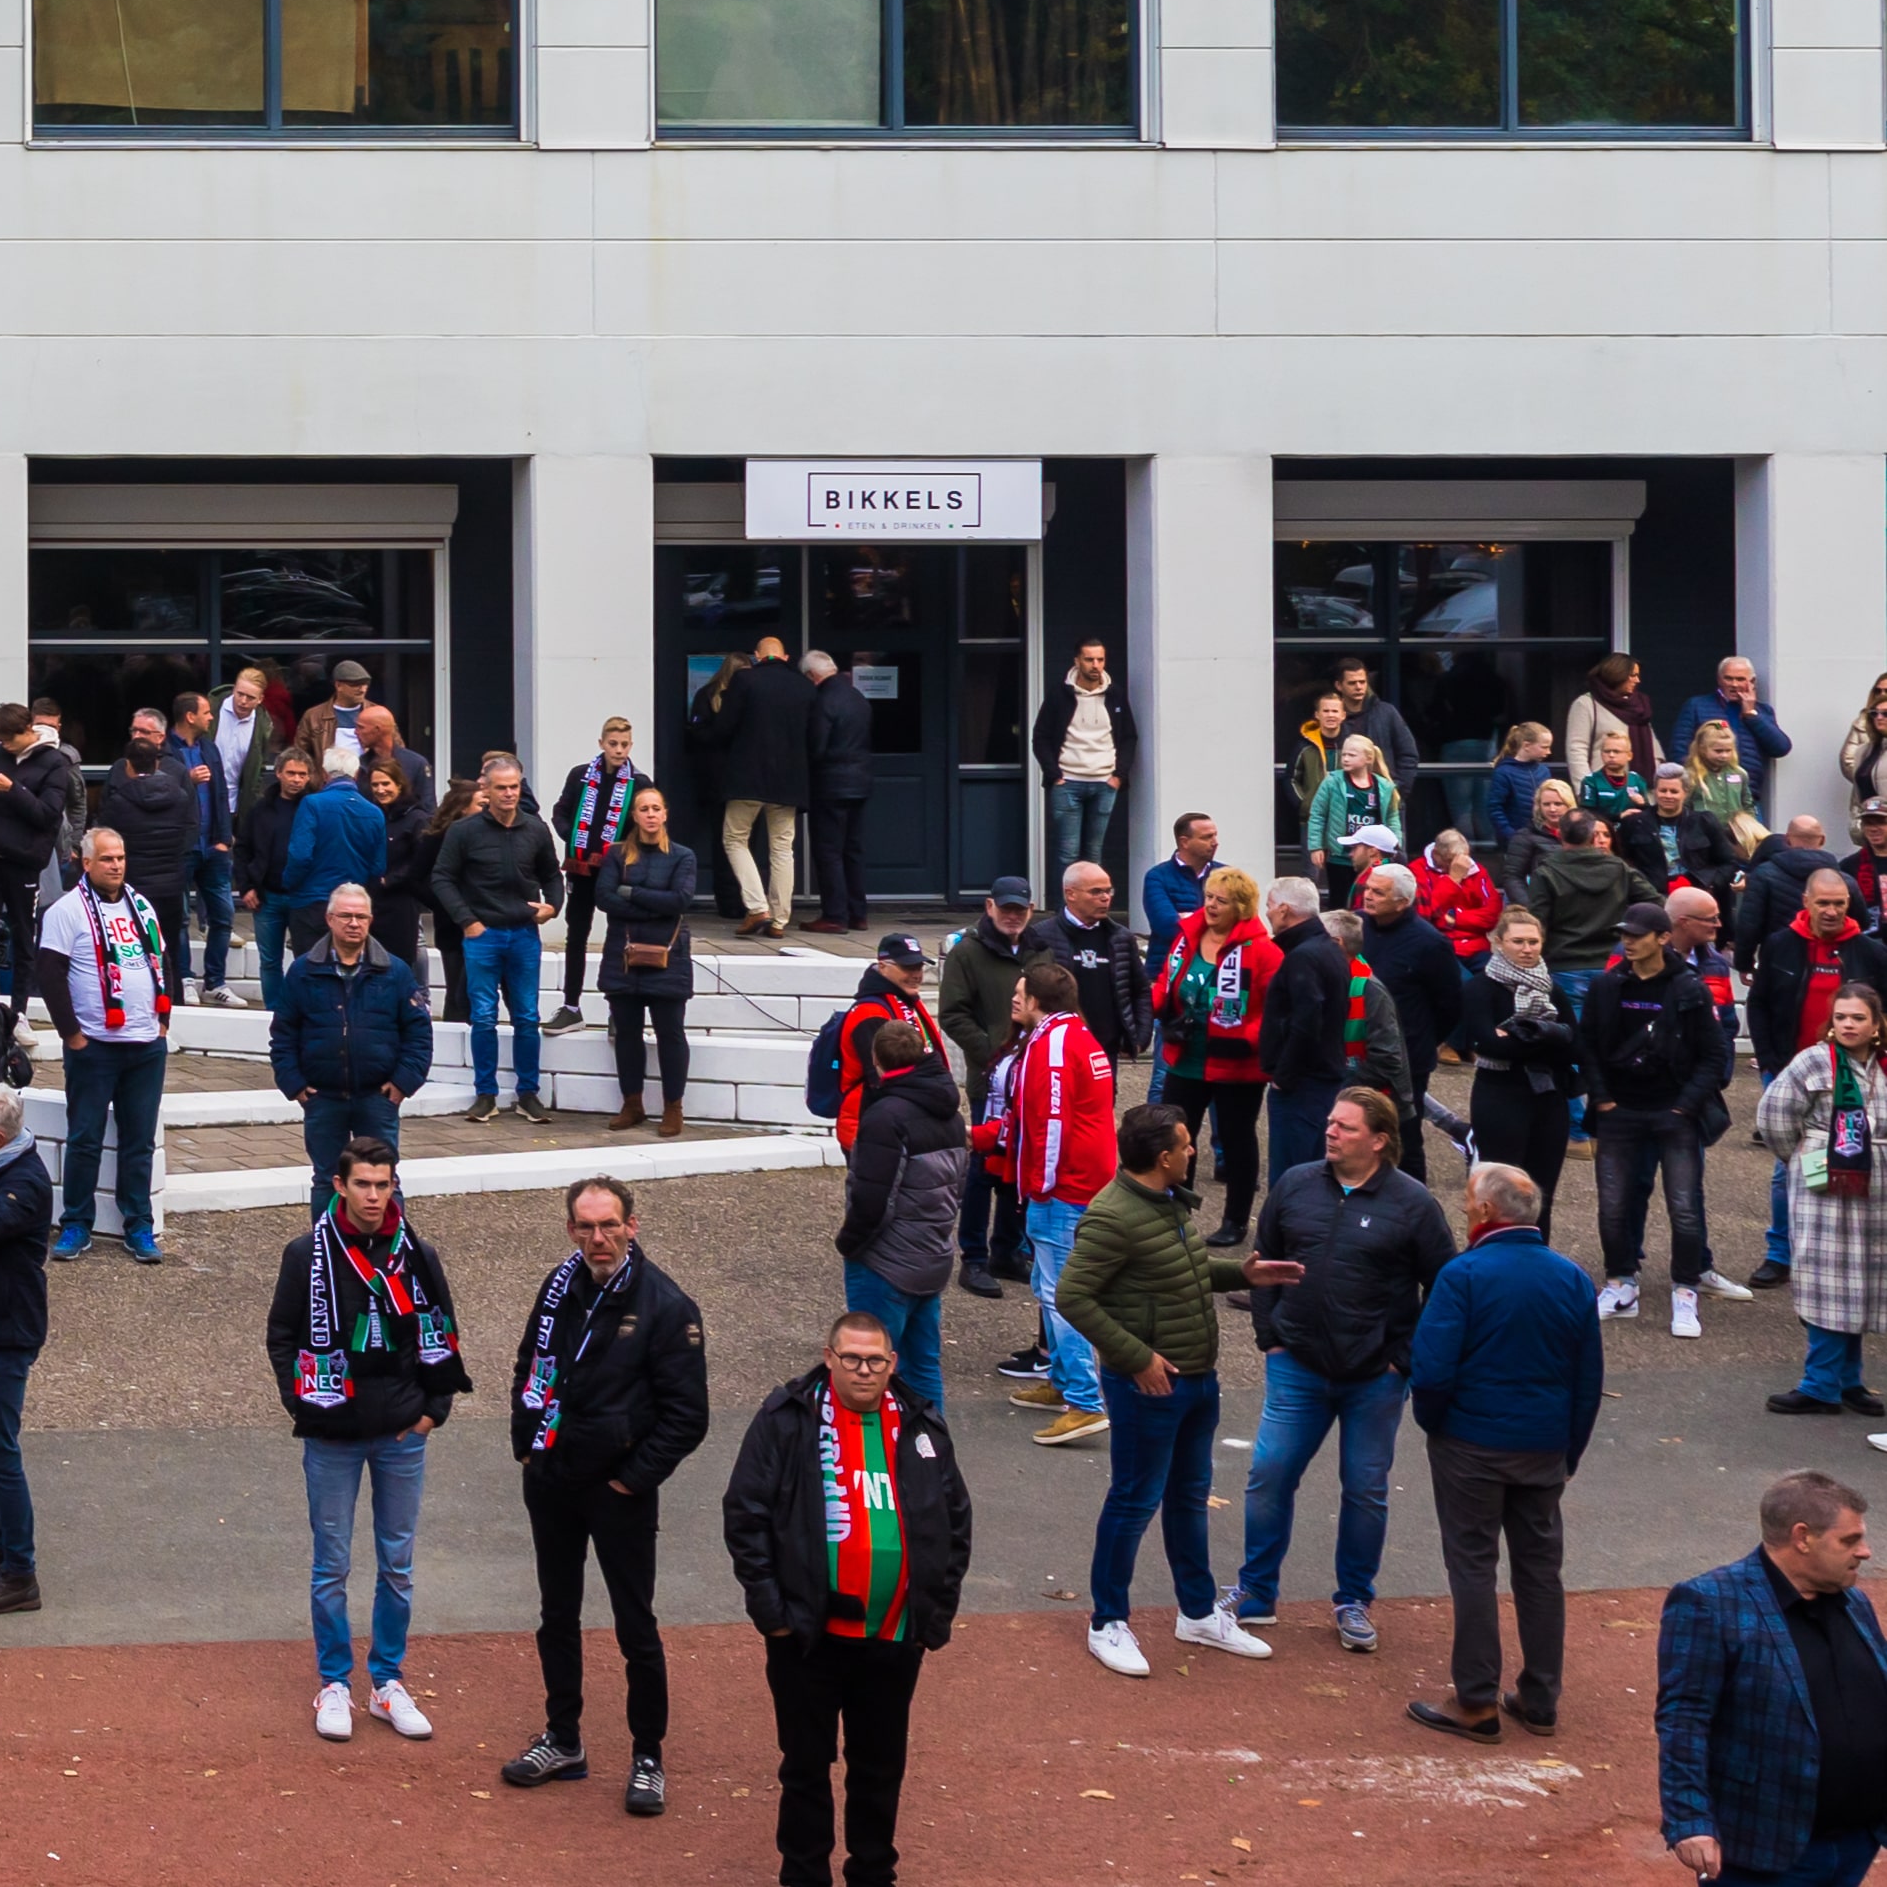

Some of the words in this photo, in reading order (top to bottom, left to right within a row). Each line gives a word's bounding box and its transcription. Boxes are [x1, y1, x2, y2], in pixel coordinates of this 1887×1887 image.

[825, 490, 964, 510] BIKKELS
[847, 521, 875, 530] ETEN
[893, 521, 941, 530] DRINKEN
[305, 1374, 342, 1389] NEC
